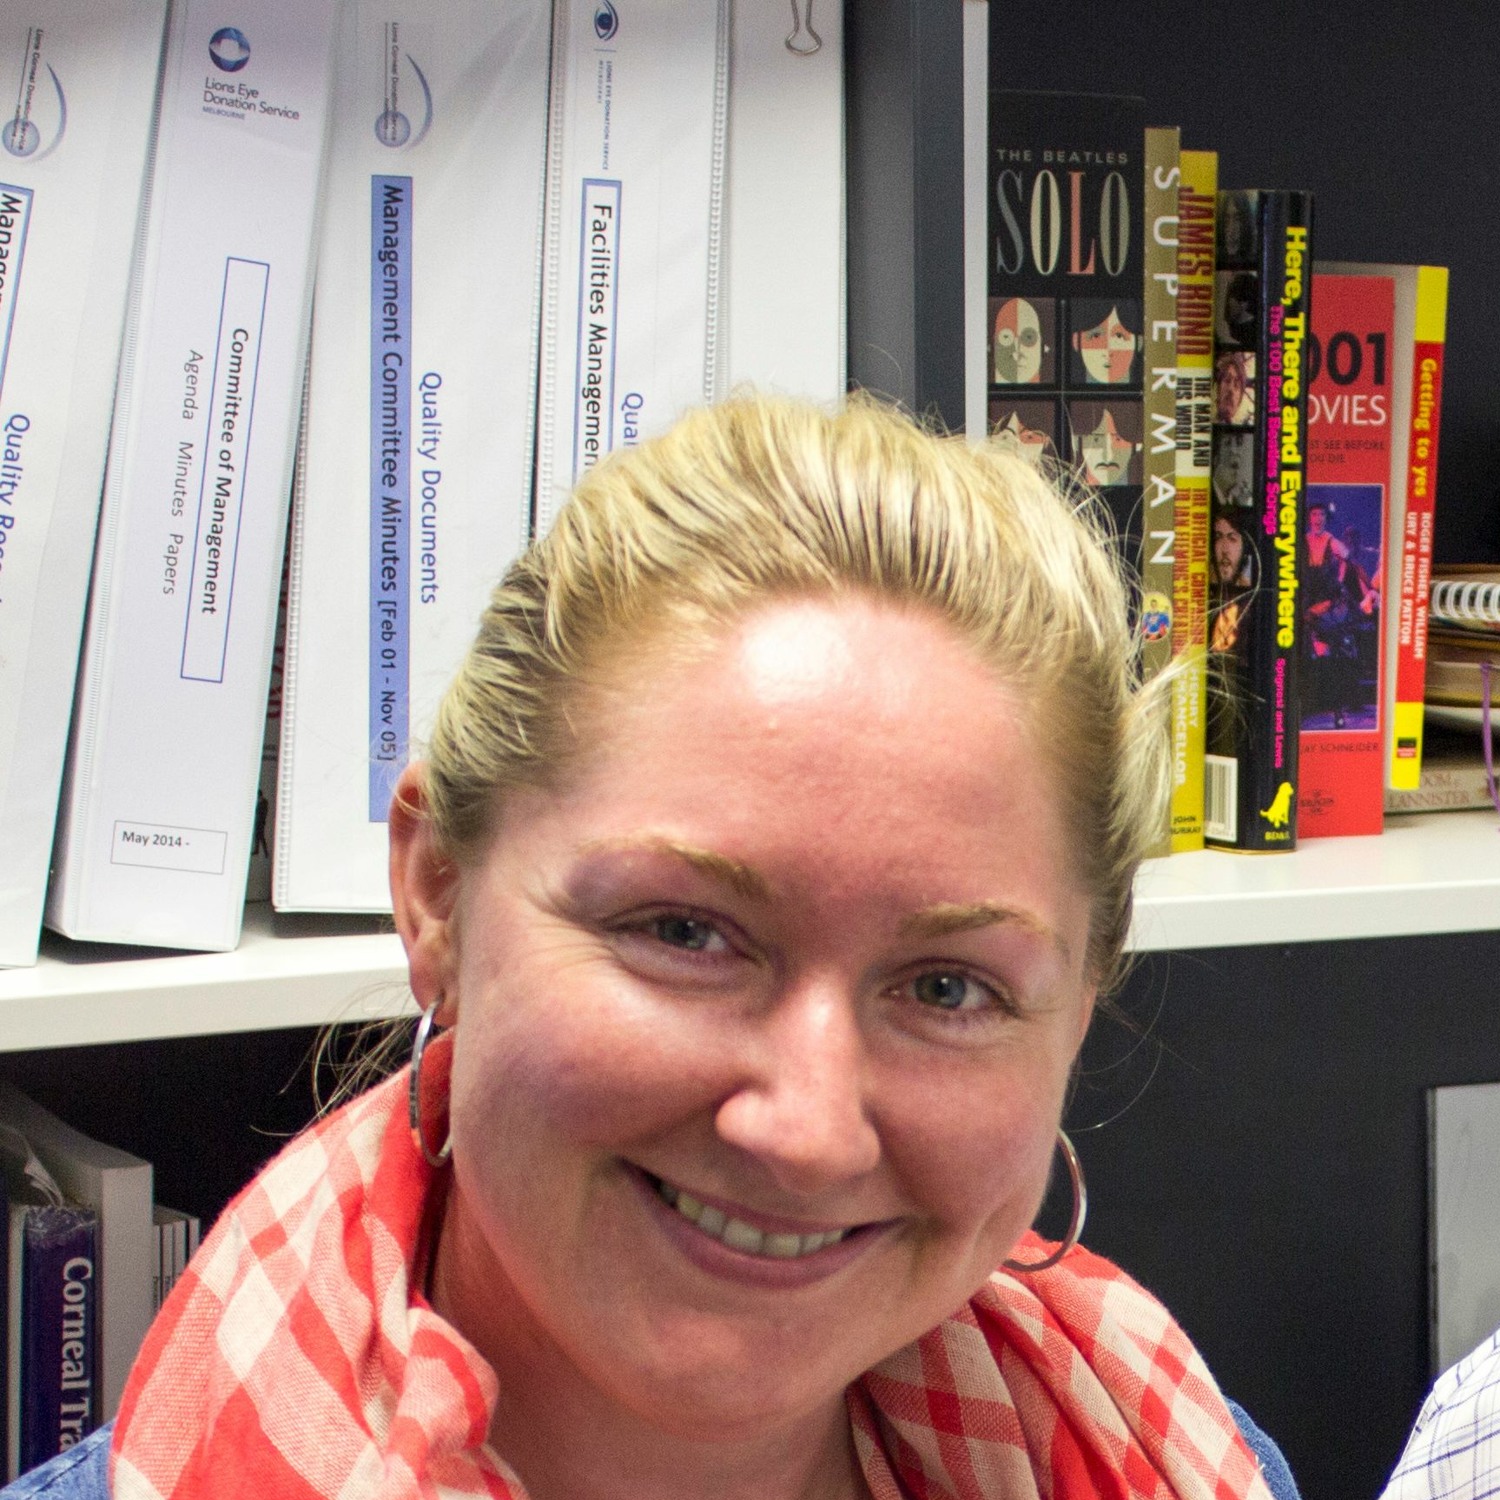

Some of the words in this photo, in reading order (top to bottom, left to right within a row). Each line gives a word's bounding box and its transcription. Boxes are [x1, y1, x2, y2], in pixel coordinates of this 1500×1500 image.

[203, 90, 256, 111] Donation
[258, 101, 300, 120] Service
[205, 77, 235, 94] Lions
[238, 83, 259, 100] Eye
[996, 150, 1032, 162] THE
[1043, 151, 1129, 164] BEATLES
[996, 169, 1131, 276] SOLO
[1177, 186, 1215, 276] JAMES
[0, 193, 22, 309] Manag
[378, 184, 403, 343] Management
[589, 204, 612, 315] Facilities
[1281, 226, 1306, 305] Here,
[1176, 284, 1213, 356] BOND
[1270, 305, 1284, 335] The
[1151, 165, 1180, 565] SUPERMAN
[1269, 340, 1283, 372] 100
[1282, 312, 1305, 399] There
[182, 349, 204, 420] Agenda
[221, 328, 249, 444] Committee
[582, 323, 607, 470] Managemen
[1175, 377, 1193, 400] HIS
[1193, 376, 1211, 397] THE
[1268, 375, 1281, 413] Best
[1413, 359, 1437, 430] Getting
[381, 352, 402, 488] Committee
[417, 372, 442, 461] Quality
[620, 392, 644, 447] Qual
[1175, 405, 1192, 451] WORLD
[1193, 402, 1211, 433] MAN
[1282, 405, 1302, 463] and
[218, 449, 235, 472] of
[1193, 439, 1210, 466] AND
[1267, 417, 1280, 478] Beatles
[1416, 437, 1431, 457] to
[171, 441, 194, 517] Minutes
[1412, 466, 1429, 497] yes
[1262, 482, 1279, 535] Songs
[1405, 511, 1418, 536] URY
[1419, 511, 1432, 552] ROGER
[201, 476, 232, 614] Management
[381, 498, 402, 592] Minutes
[420, 470, 441, 604] Documents
[1274, 471, 1302, 648] Everywhere
[1404, 541, 1416, 550] &
[163, 533, 184, 596] Papers
[1402, 555, 1415, 594] BRUCE
[1416, 557, 1430, 602] FISHER,
[377, 600, 397, 642] [Feb
[1399, 599, 1412, 645] PATTON
[1412, 606, 1428, 660] WILLIAM
[380, 649, 396, 669] 01
[380, 690, 396, 726] Nov
[1188, 667, 1199, 728] HENRY
[1274, 711, 1284, 732] and
[377, 731, 396, 761] 05]
[1274, 735, 1284, 768] Lewis
[122, 831, 149, 846] May
[152, 834, 182, 847] 2014
[61, 1258, 93, 1391] Corneal
